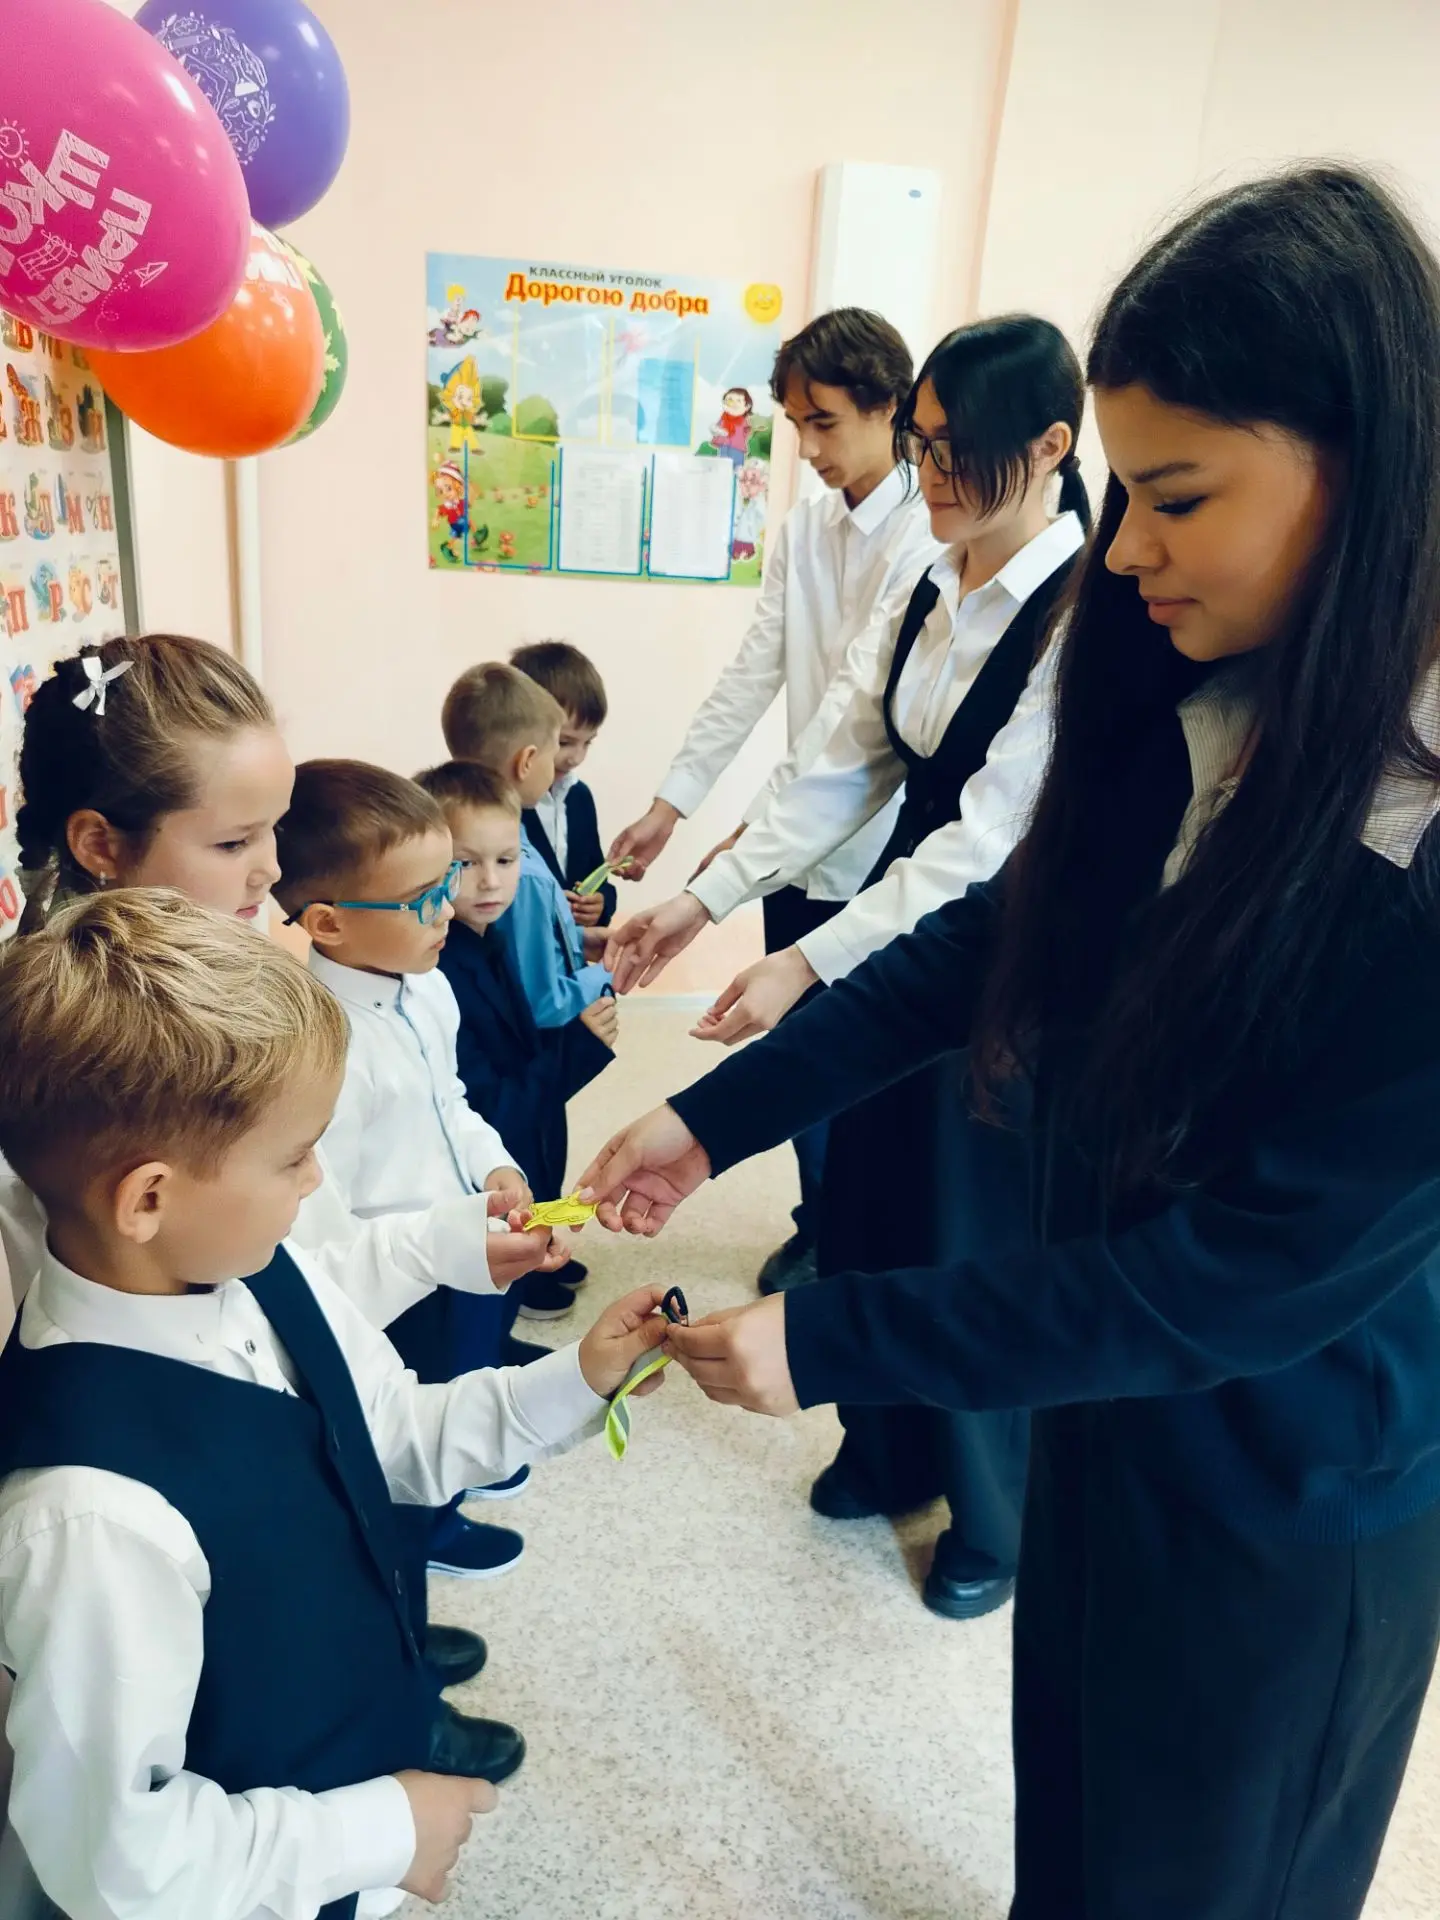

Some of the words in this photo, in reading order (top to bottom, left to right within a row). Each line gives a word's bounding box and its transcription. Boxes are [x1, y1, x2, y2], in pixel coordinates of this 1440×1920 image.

[27, 187, 152, 325] ПРИВЕТ
[529, 265, 605, 283] КЛАССНЫЙ
[609, 273, 662, 288] УГОЛОК
[505, 272, 624, 307] Дорогою
[629, 289, 709, 317] добра
[8, 590, 30, 633] П
